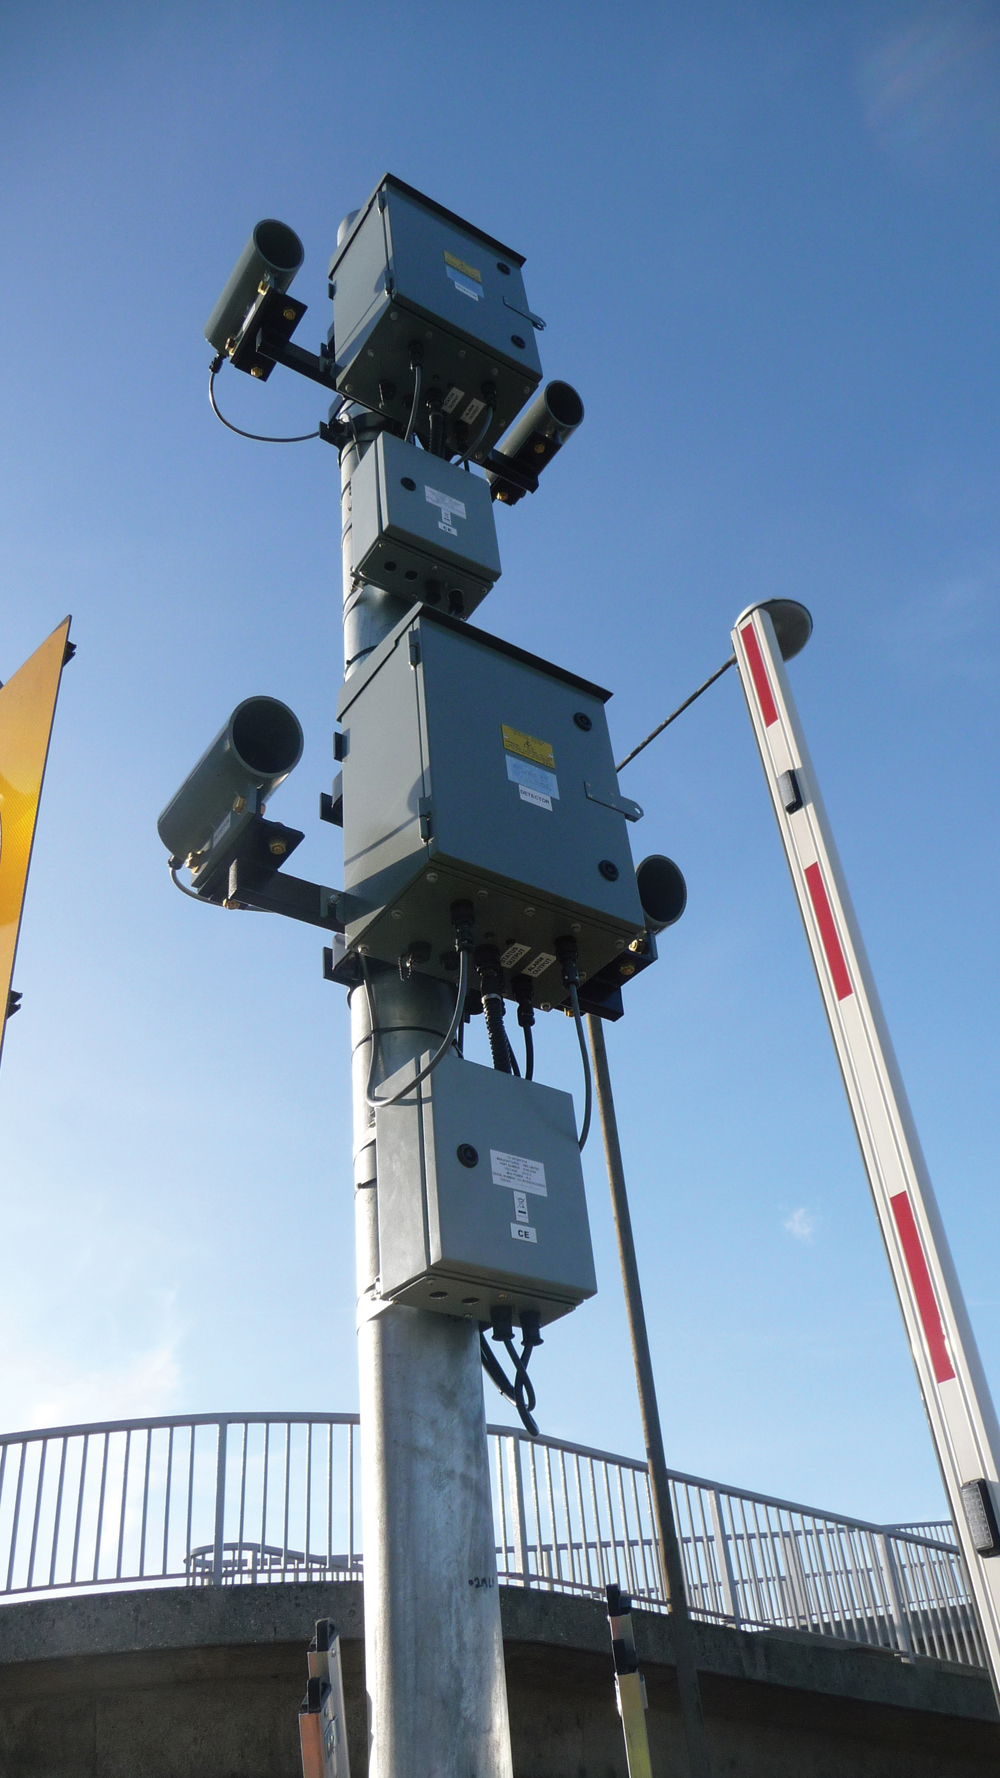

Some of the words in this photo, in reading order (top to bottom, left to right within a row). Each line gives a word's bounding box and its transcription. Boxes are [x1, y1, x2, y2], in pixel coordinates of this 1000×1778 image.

[520, 789, 550, 804] DETECTOR
[501, 947, 518, 964] STATUS
[507, 948, 525, 966] OUTPUT
[528, 957, 545, 972] ALARM
[533, 958, 552, 974] OUTPUT
[518, 1230, 530, 1239] CE
